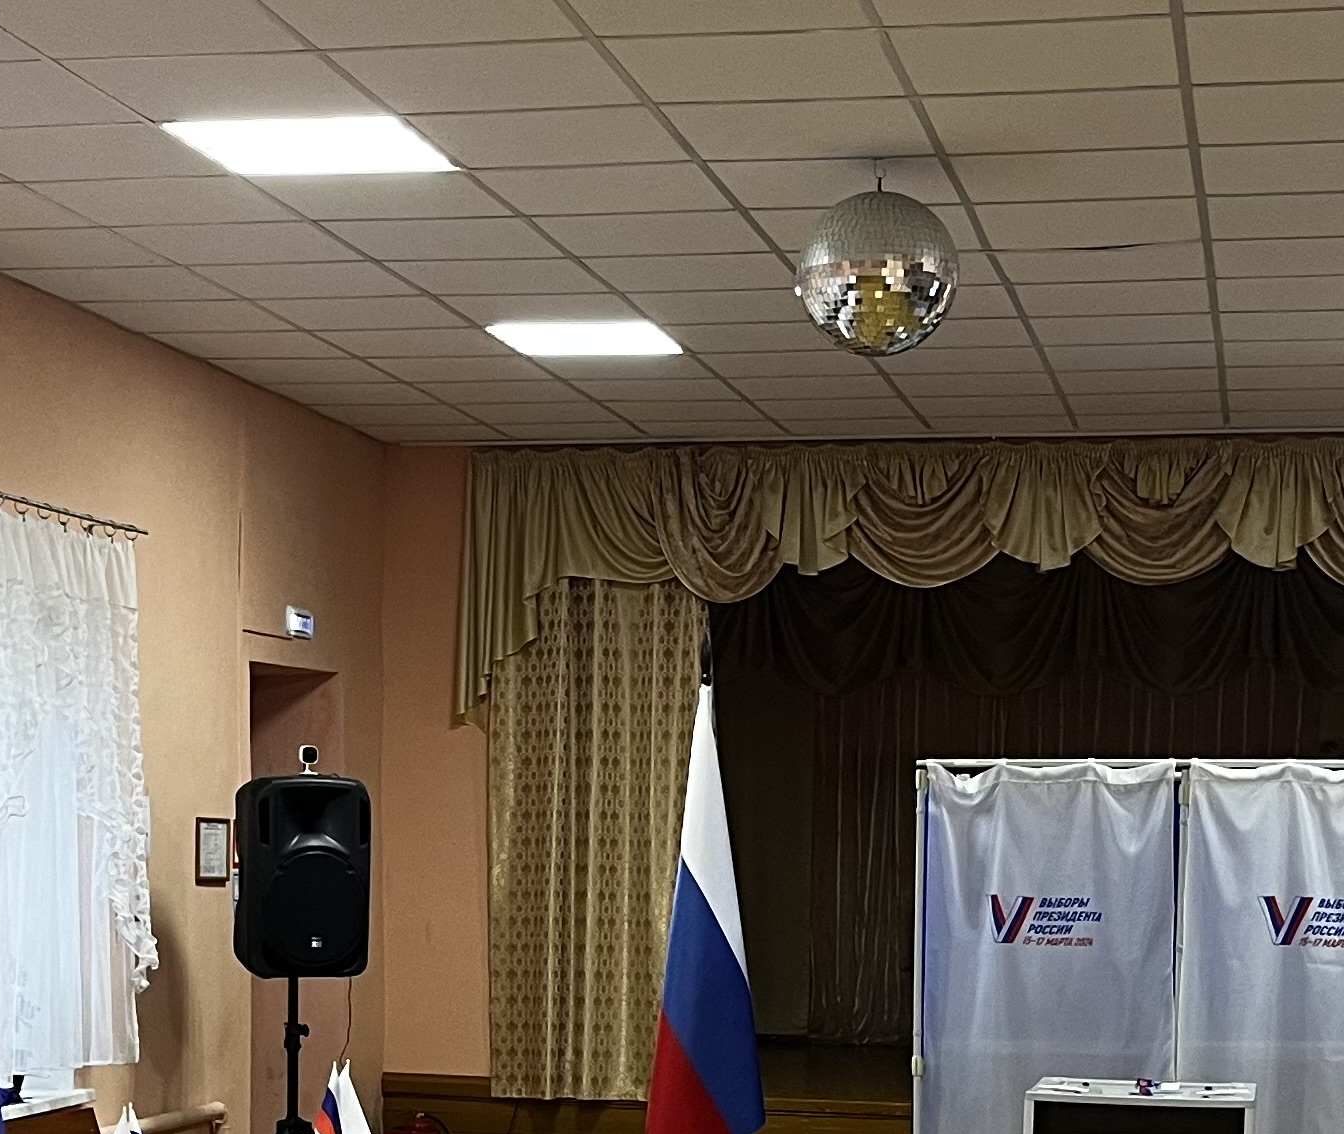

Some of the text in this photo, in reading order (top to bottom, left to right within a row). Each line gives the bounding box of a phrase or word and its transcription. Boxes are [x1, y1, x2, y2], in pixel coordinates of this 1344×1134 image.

[1039, 897, 1090, 908] ВЫБОРЫ
[1033, 911, 1102, 922] ПРЕЗИДЕНТА
[1027, 924, 1073, 935] РОССИИ
